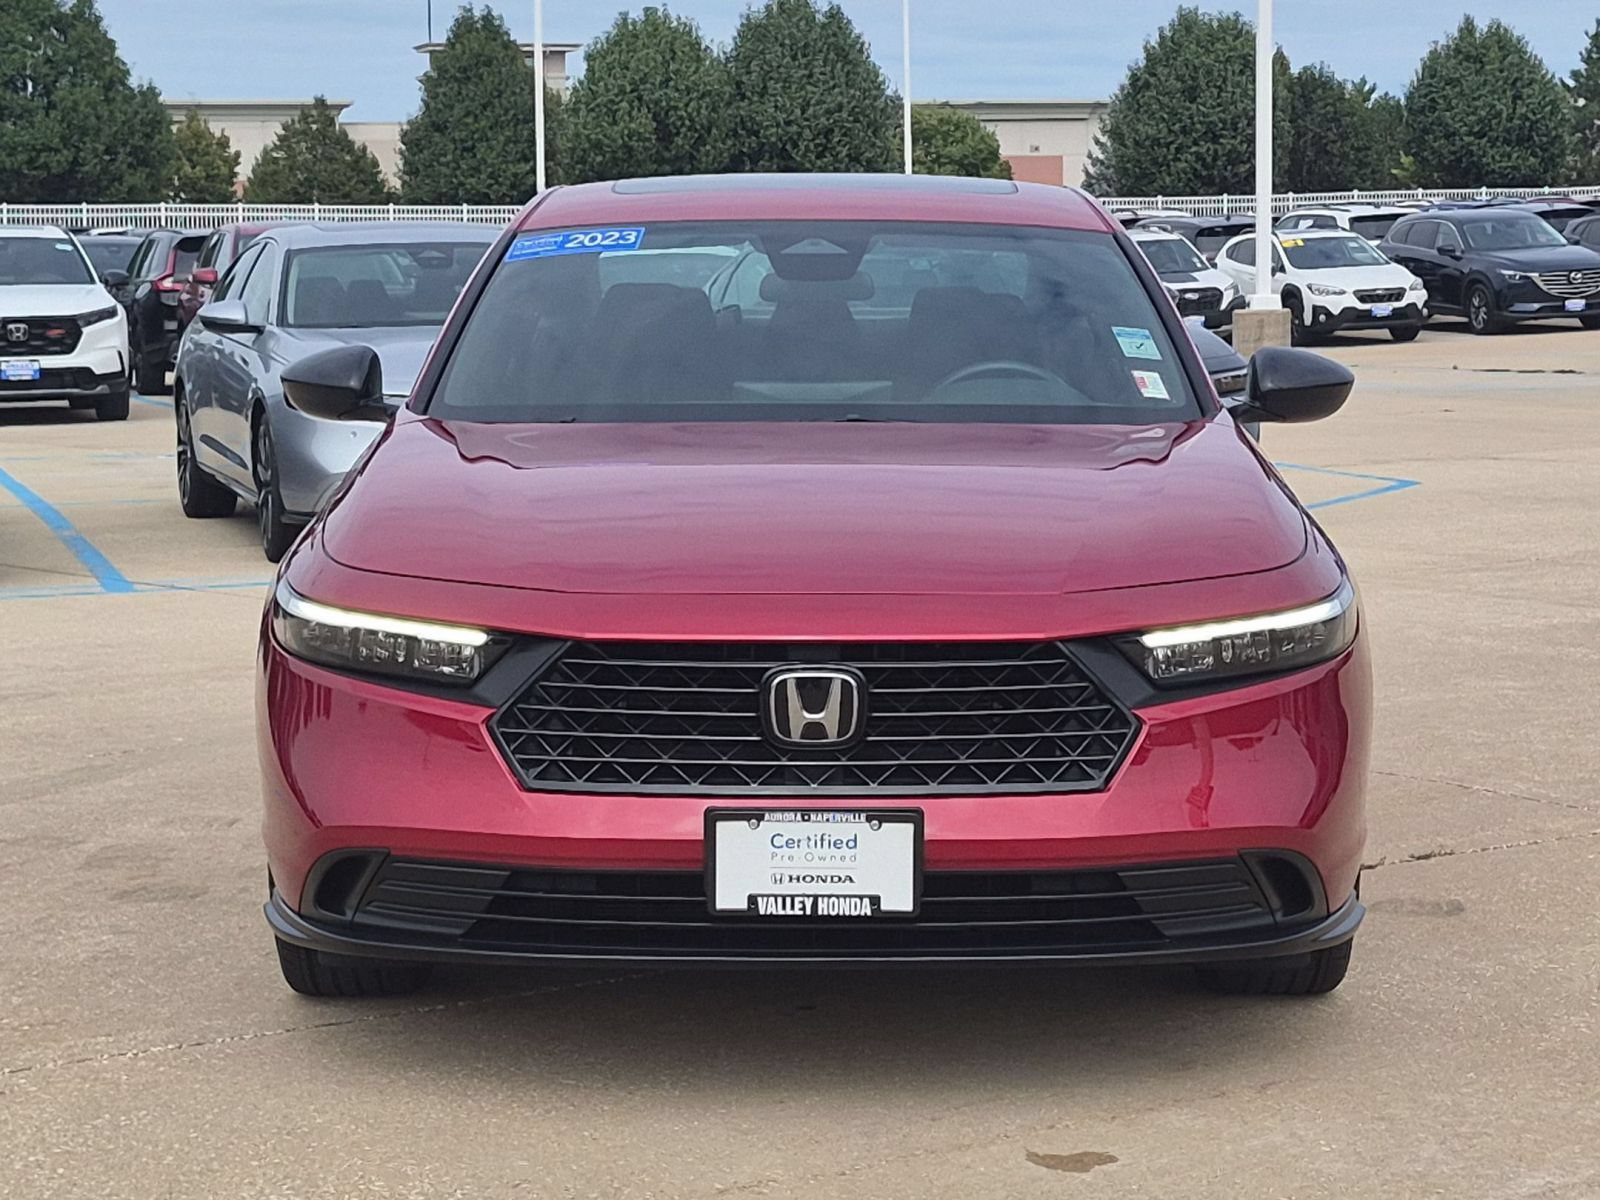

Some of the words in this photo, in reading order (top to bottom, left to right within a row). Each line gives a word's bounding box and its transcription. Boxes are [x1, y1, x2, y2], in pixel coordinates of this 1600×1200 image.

[564, 230, 638, 248] 2023
[770, 833, 858, 850] Certified
[788, 874, 856, 884] HONDA
[757, 897, 813, 916] VALLEY
[817, 897, 872, 916] HONDA
